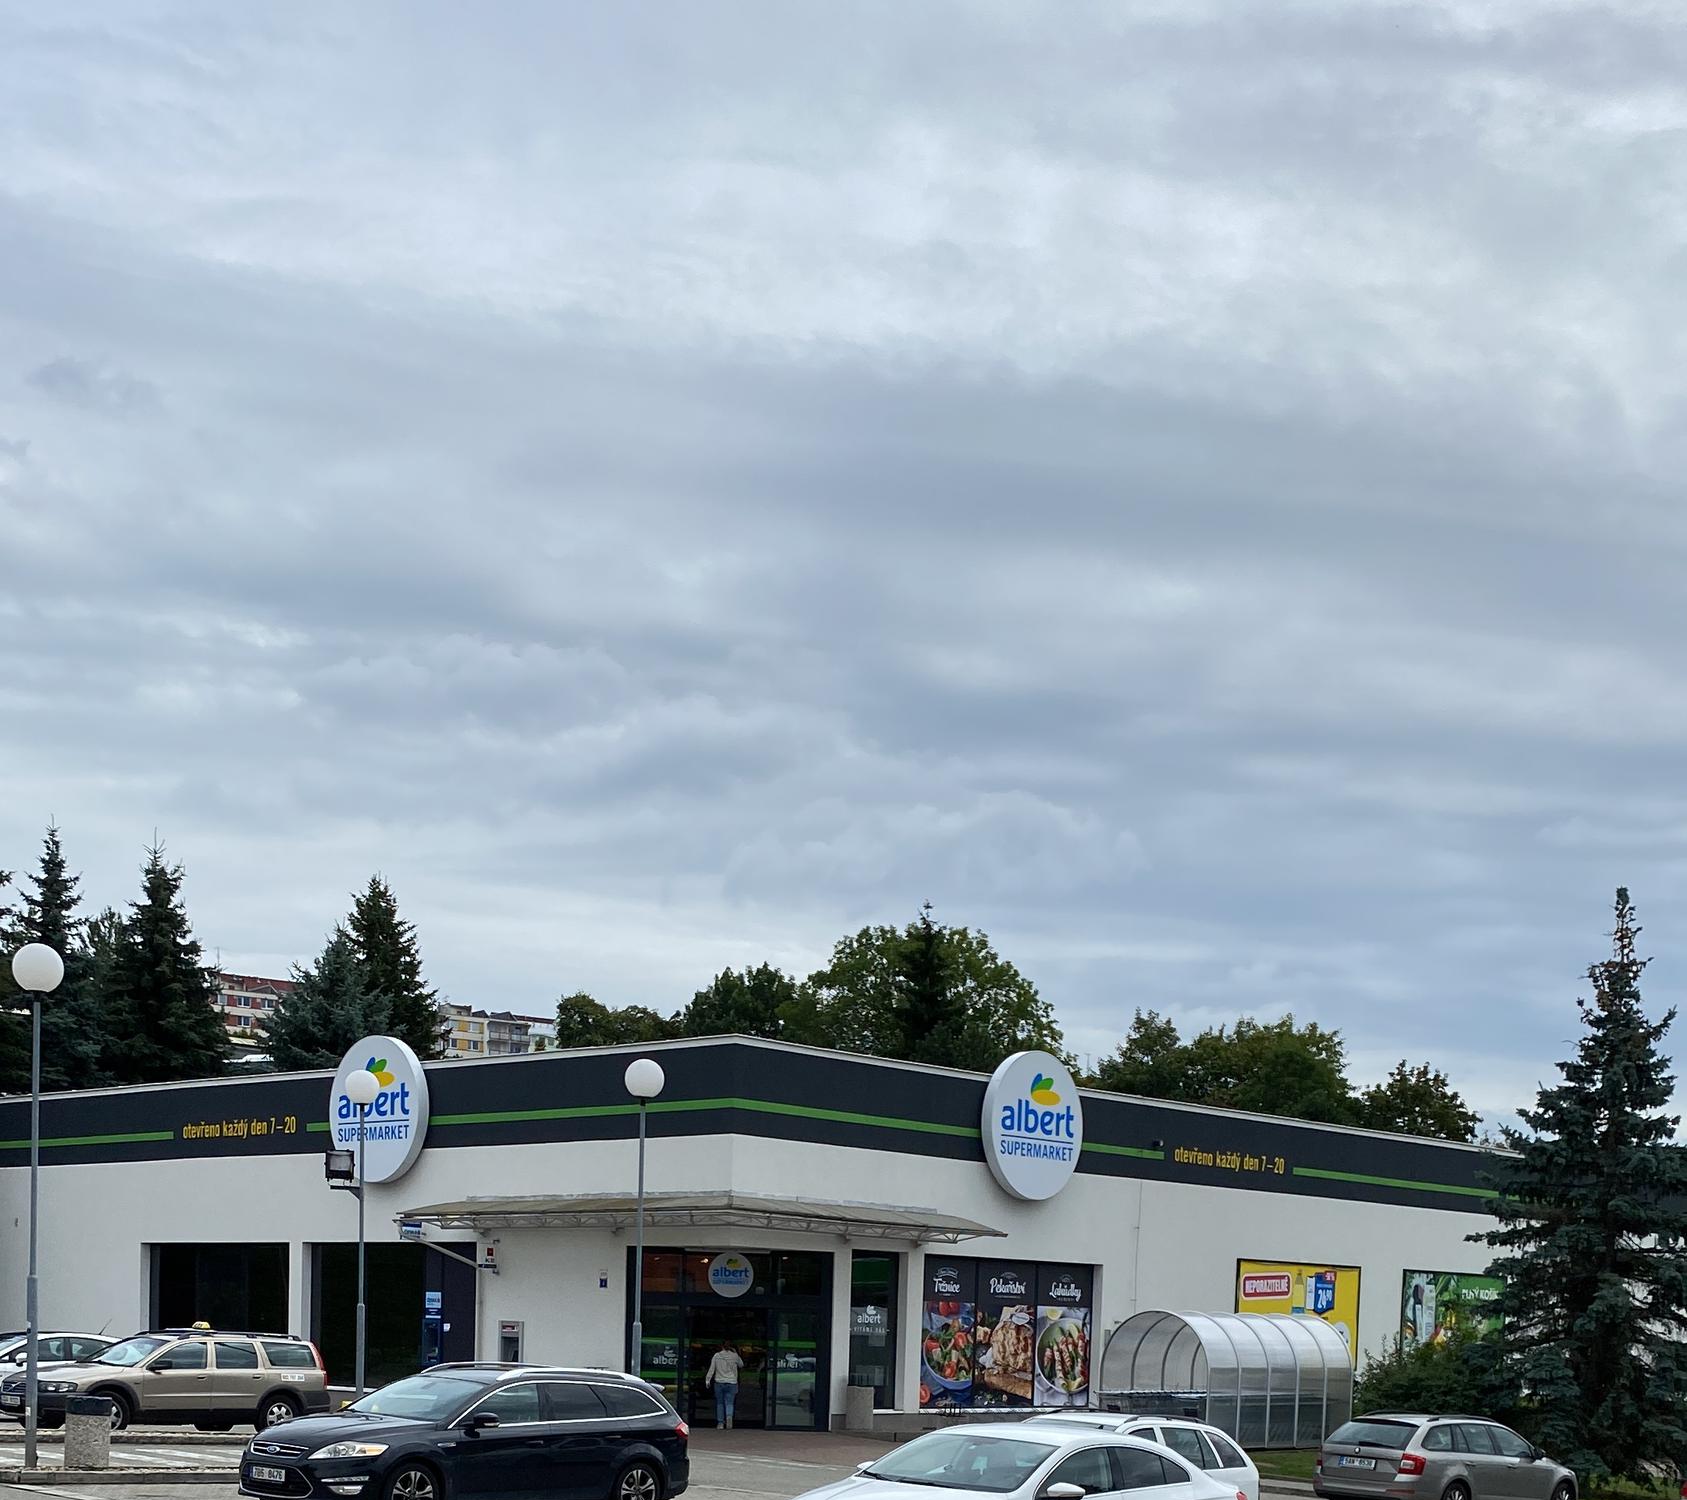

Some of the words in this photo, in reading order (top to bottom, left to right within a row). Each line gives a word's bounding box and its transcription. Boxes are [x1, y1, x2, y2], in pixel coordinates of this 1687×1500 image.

[338, 1082, 410, 1119] aert
[1001, 1098, 1074, 1138] albert
[182, 1121, 220, 1139] otevřeno
[222, 1119, 249, 1139] každý
[250, 1119, 267, 1135] den
[1000, 1139, 1074, 1162] SUPERMARKET
[1174, 1146, 1214, 1167] otevřeno
[1215, 1150, 1241, 1172] každý
[1243, 1153, 1260, 1171] den
[712, 1266, 750, 1278] albert
[857, 1313, 881, 1324] albert
[652, 1354, 679, 1366] alber
